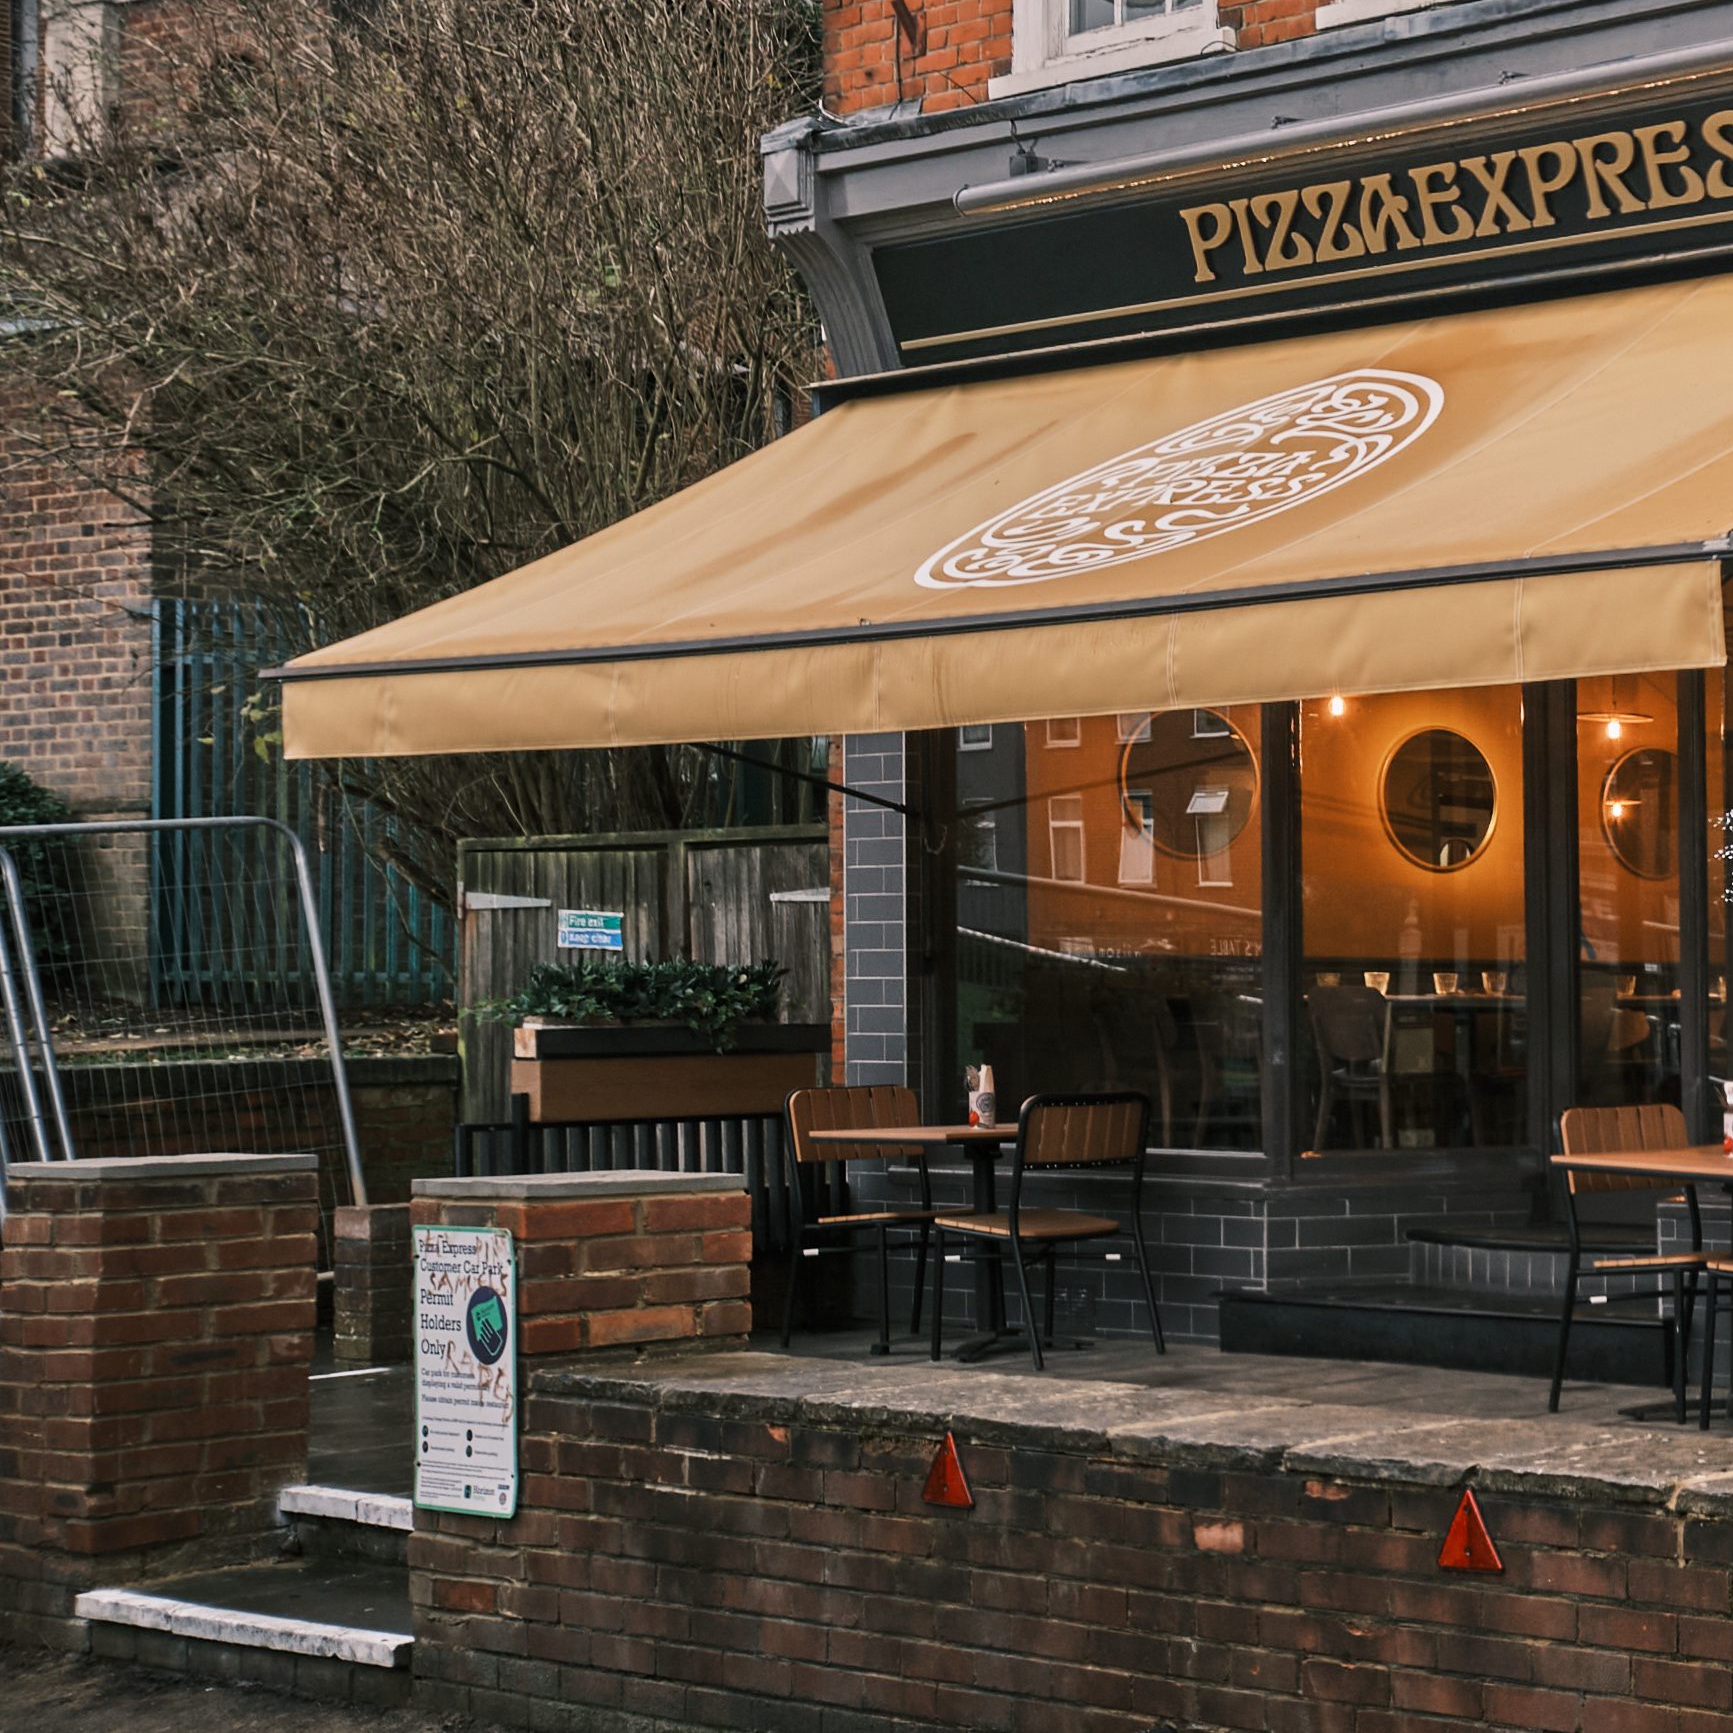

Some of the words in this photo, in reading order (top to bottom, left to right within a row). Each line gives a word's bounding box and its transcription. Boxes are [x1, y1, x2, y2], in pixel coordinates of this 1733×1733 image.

[1131, 450, 1318, 486] PIZZA
[1022, 472, 1326, 521] EXPRESS
[569, 914, 586, 926] Fire
[442, 1240, 477, 1258] Express
[420, 1258, 461, 1273] Customer
[463, 1260, 480, 1274] Car
[482, 1262, 503, 1275] Park
[420, 1289, 454, 1307] Permit
[421, 1314, 462, 1332] Holders
[421, 1339, 446, 1359] Only
